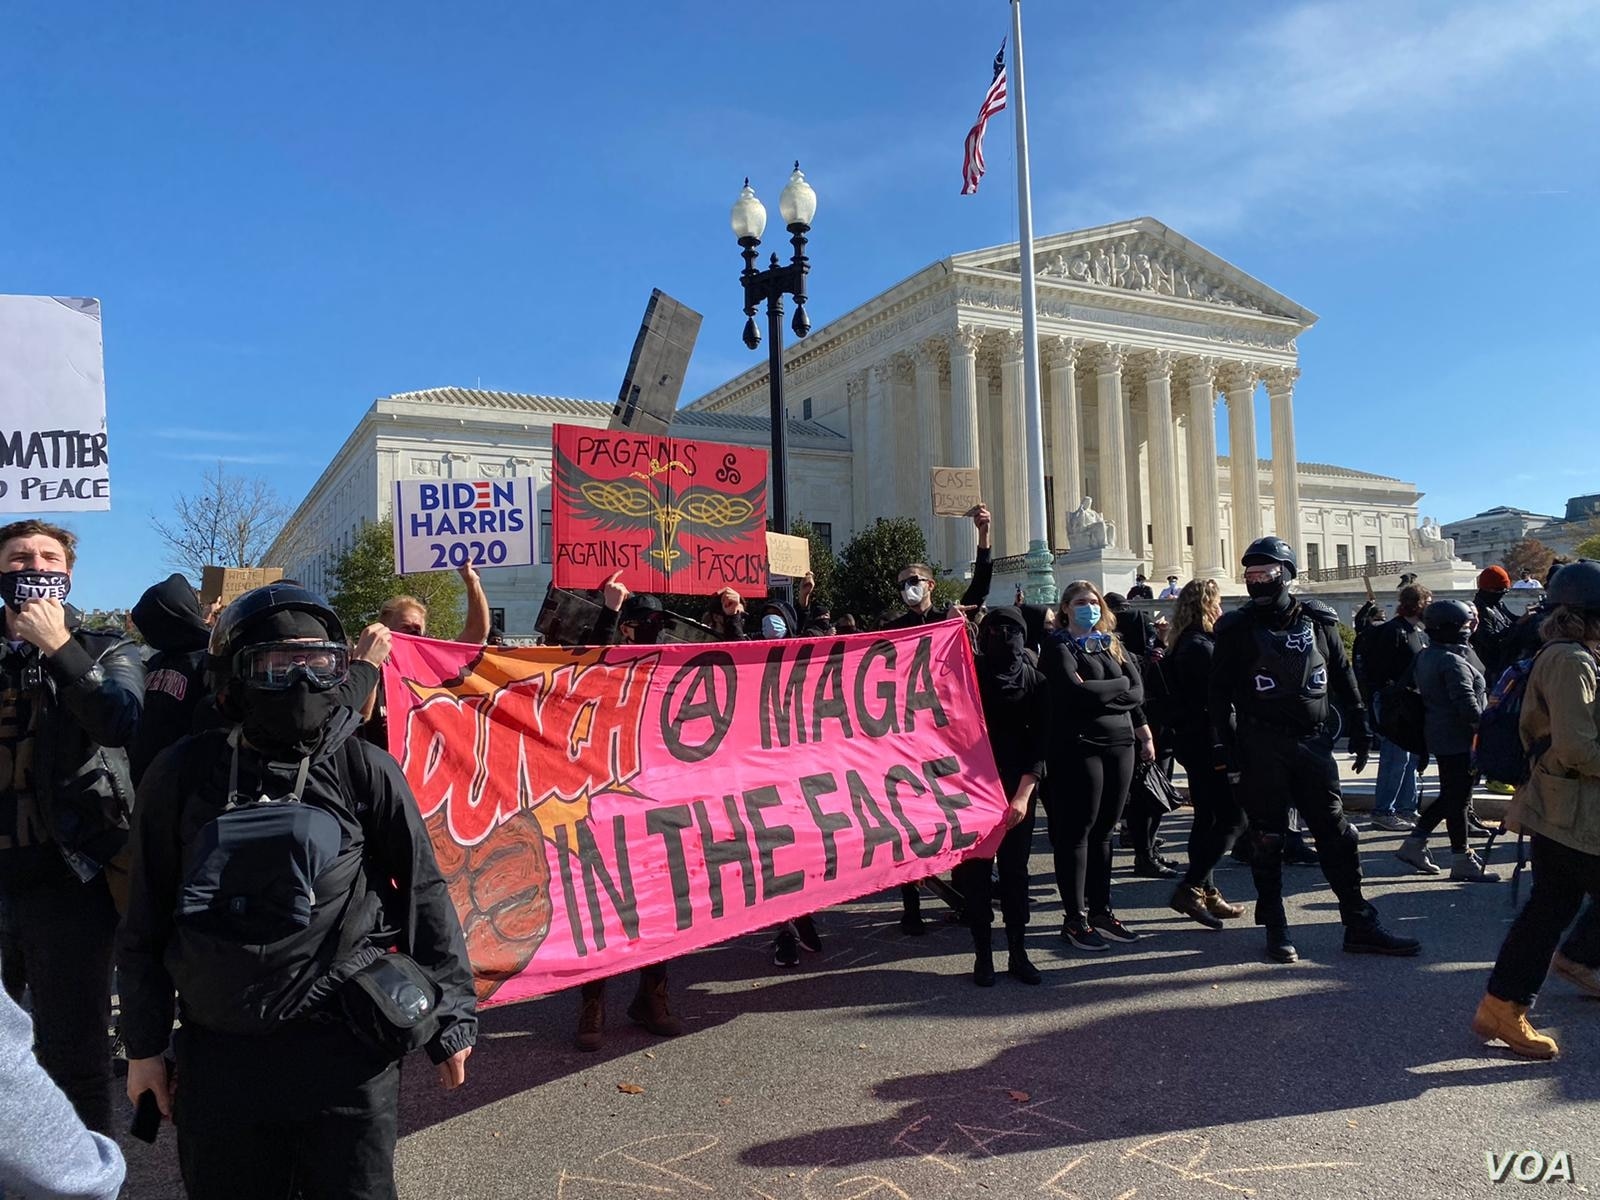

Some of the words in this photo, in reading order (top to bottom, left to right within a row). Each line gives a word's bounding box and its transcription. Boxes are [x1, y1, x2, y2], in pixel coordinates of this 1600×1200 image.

[0, 429, 108, 469] MATTER
[577, 436, 697, 477] PAGANS
[21, 477, 109, 501] PEACE
[934, 469, 973, 488] CASE
[420, 481, 514, 511] BIDEN
[411, 508, 524, 537] HARRIS
[430, 540, 507, 568] 2020
[556, 540, 642, 571] AGAINST
[696, 544, 770, 585] FASCISM
[16, 585, 66, 600] LIVES
[758, 635, 950, 750] MAGA
[555, 814, 640, 957] IN
[646, 784, 805, 932] THE
[799, 755, 980, 882] FACE
